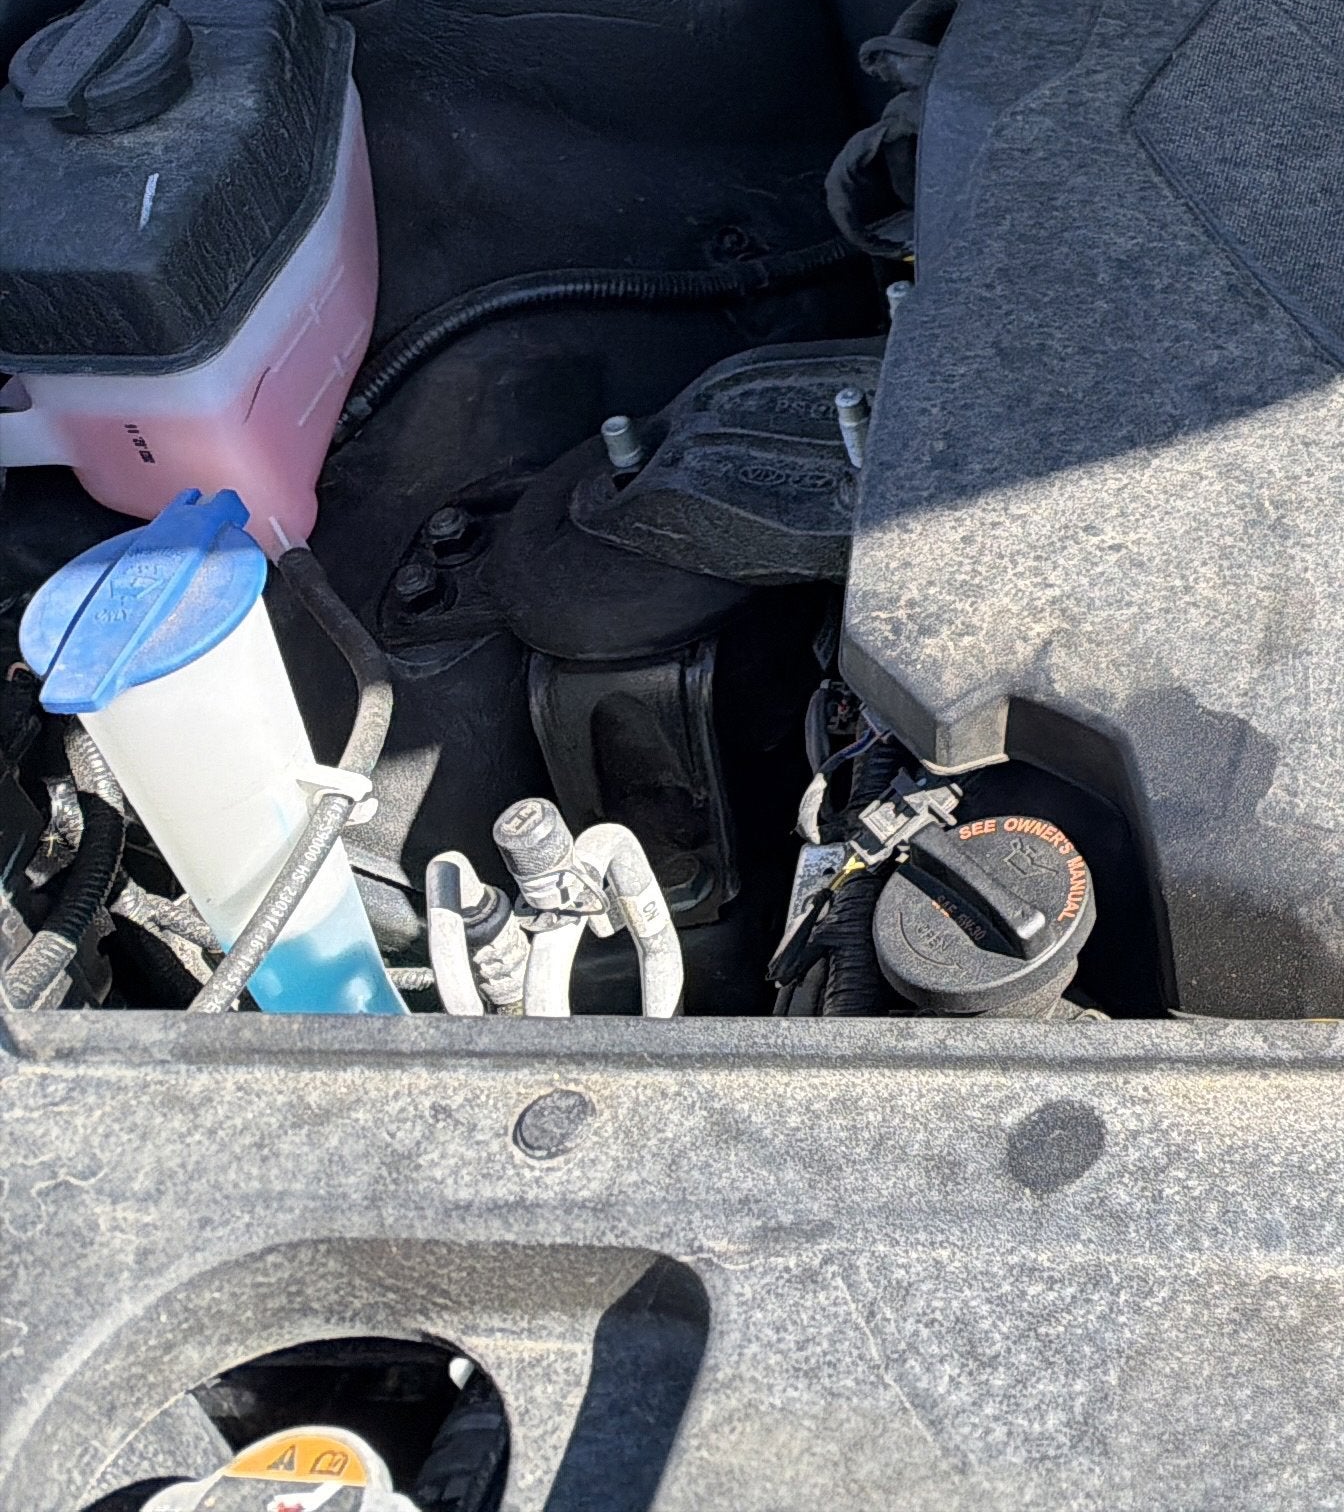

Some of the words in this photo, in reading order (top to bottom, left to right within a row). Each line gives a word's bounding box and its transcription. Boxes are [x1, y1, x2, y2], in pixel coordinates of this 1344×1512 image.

[290, 863, 312, 885] HS
[959, 819, 996, 841] SEE
[1003, 817, 1074, 855] OWNER'S
[1057, 855, 1087, 922] MANUAL
[261, 885, 298, 933] 230314
[931, 895, 958, 919] SAE
